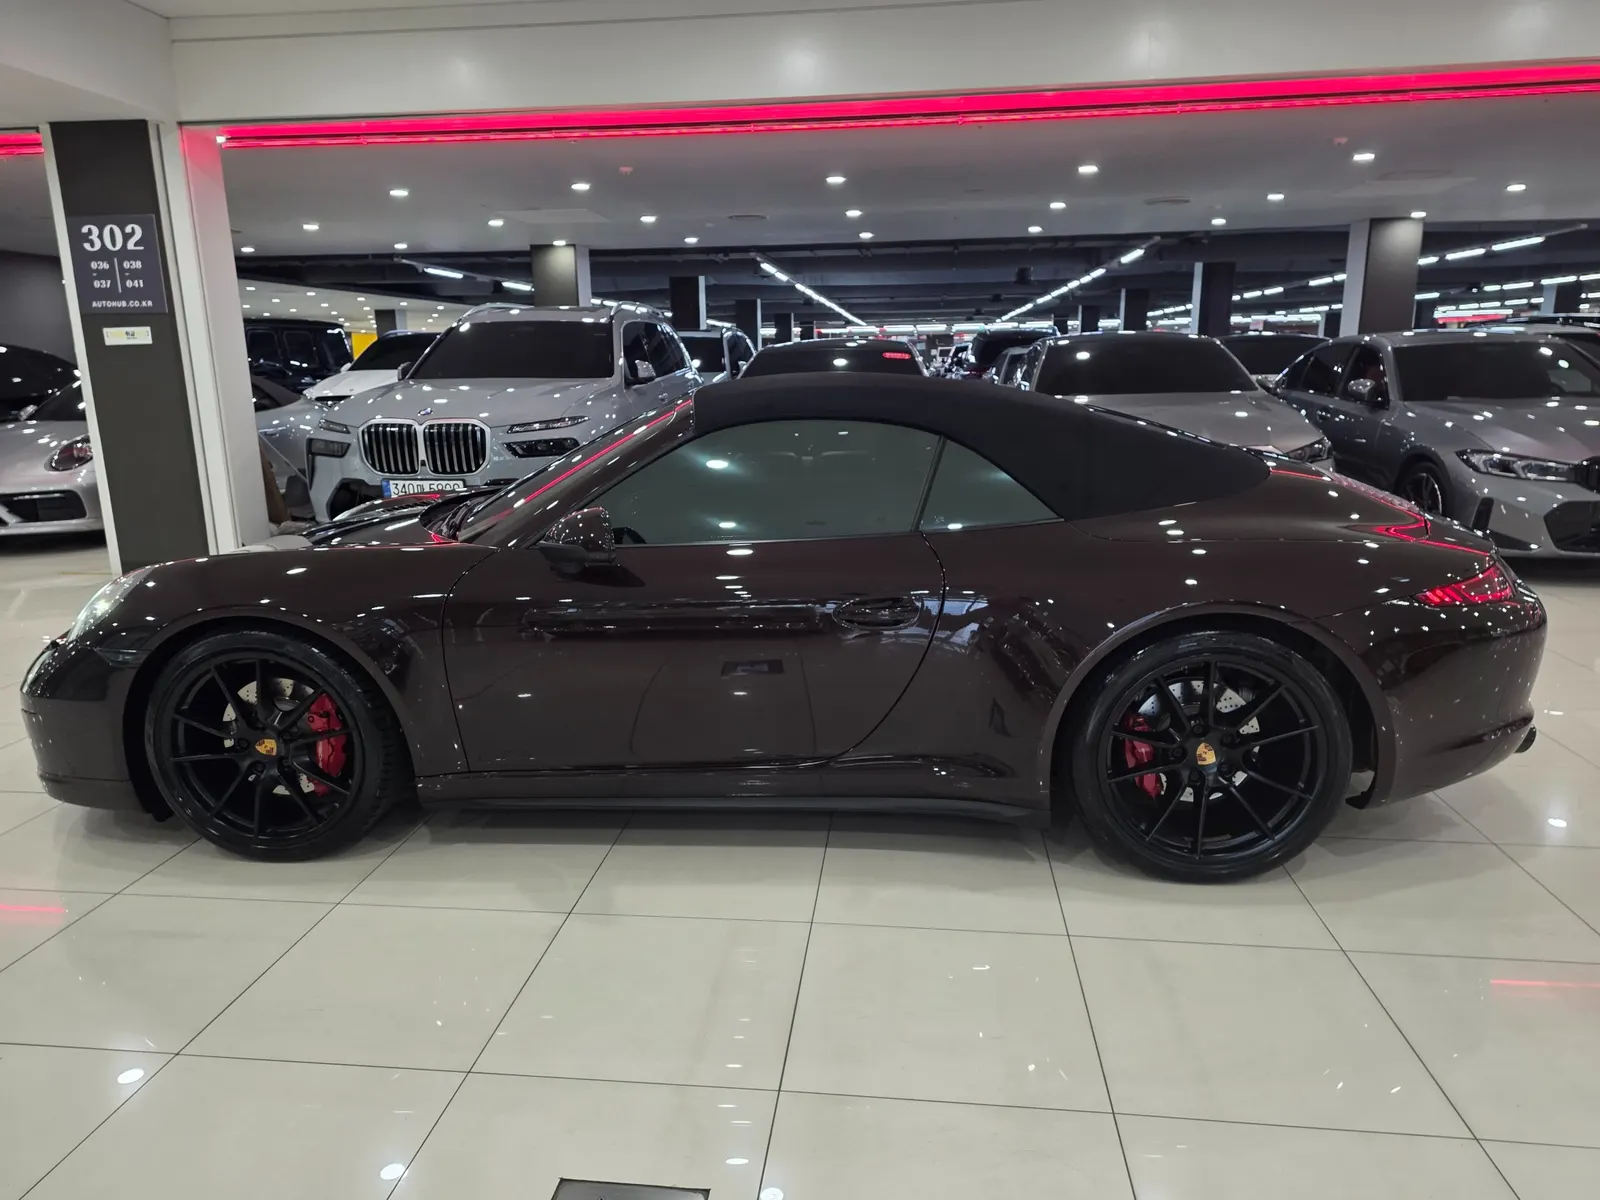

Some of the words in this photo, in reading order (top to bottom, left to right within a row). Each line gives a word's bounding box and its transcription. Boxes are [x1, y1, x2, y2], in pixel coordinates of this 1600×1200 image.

[81, 224, 144, 252] 302
[90, 261, 110, 270] 036
[123, 260, 142, 269] 038
[93, 280, 111, 288] 037
[126, 279, 144, 288] 041
[92, 300, 153, 308] AUTOHUB.CO.KR
